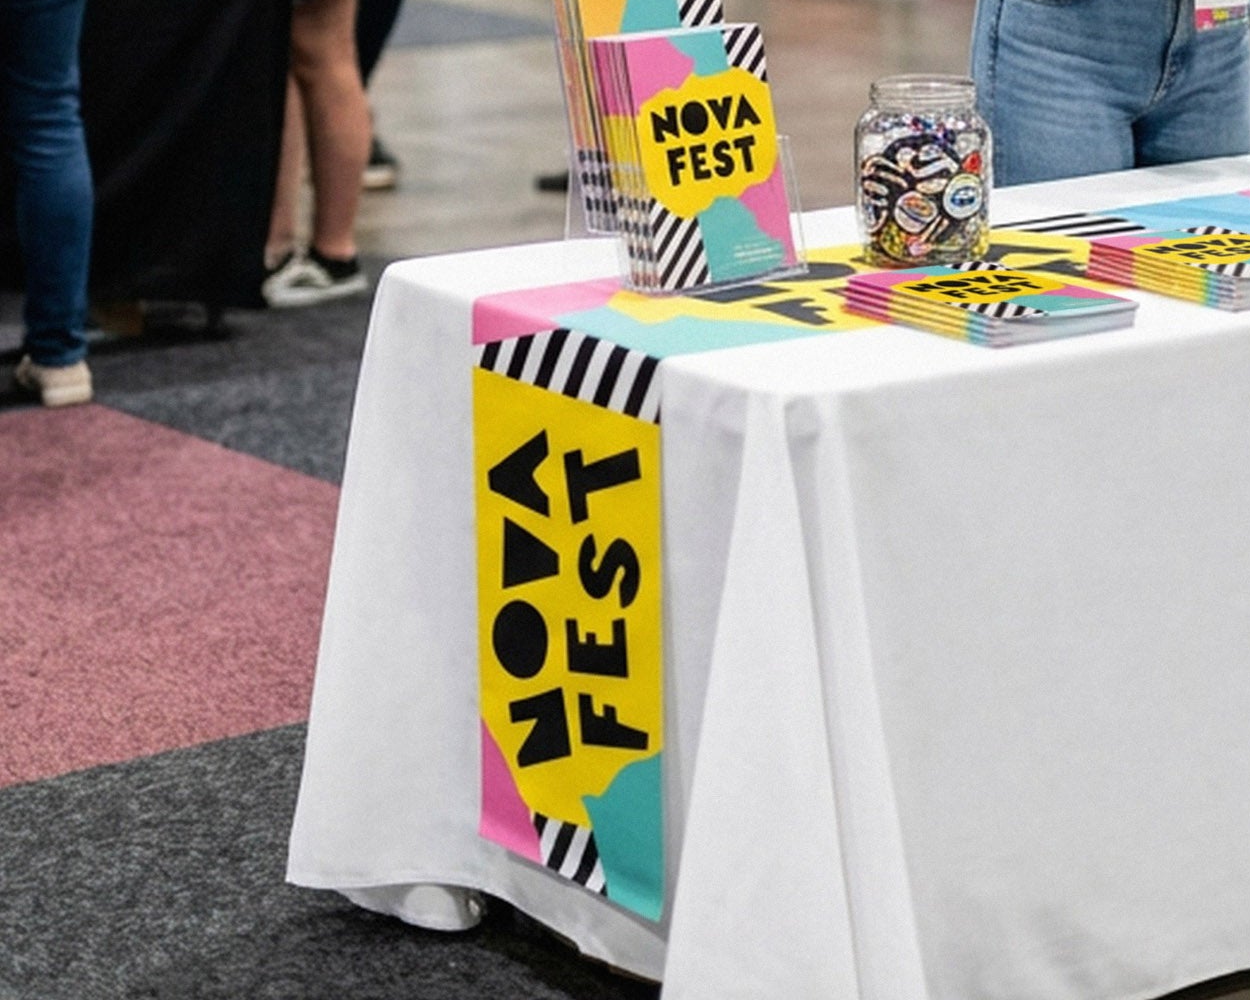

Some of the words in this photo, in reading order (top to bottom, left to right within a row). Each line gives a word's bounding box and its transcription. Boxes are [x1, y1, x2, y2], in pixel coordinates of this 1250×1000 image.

[650, 94, 762, 143] NOVA
[666, 135, 756, 187] FEST
[903, 274, 1028, 292] NOVA
[938, 281, 1044, 299] FEST
[487, 429, 572, 768] NOVA
[563, 446, 650, 750] FEST
